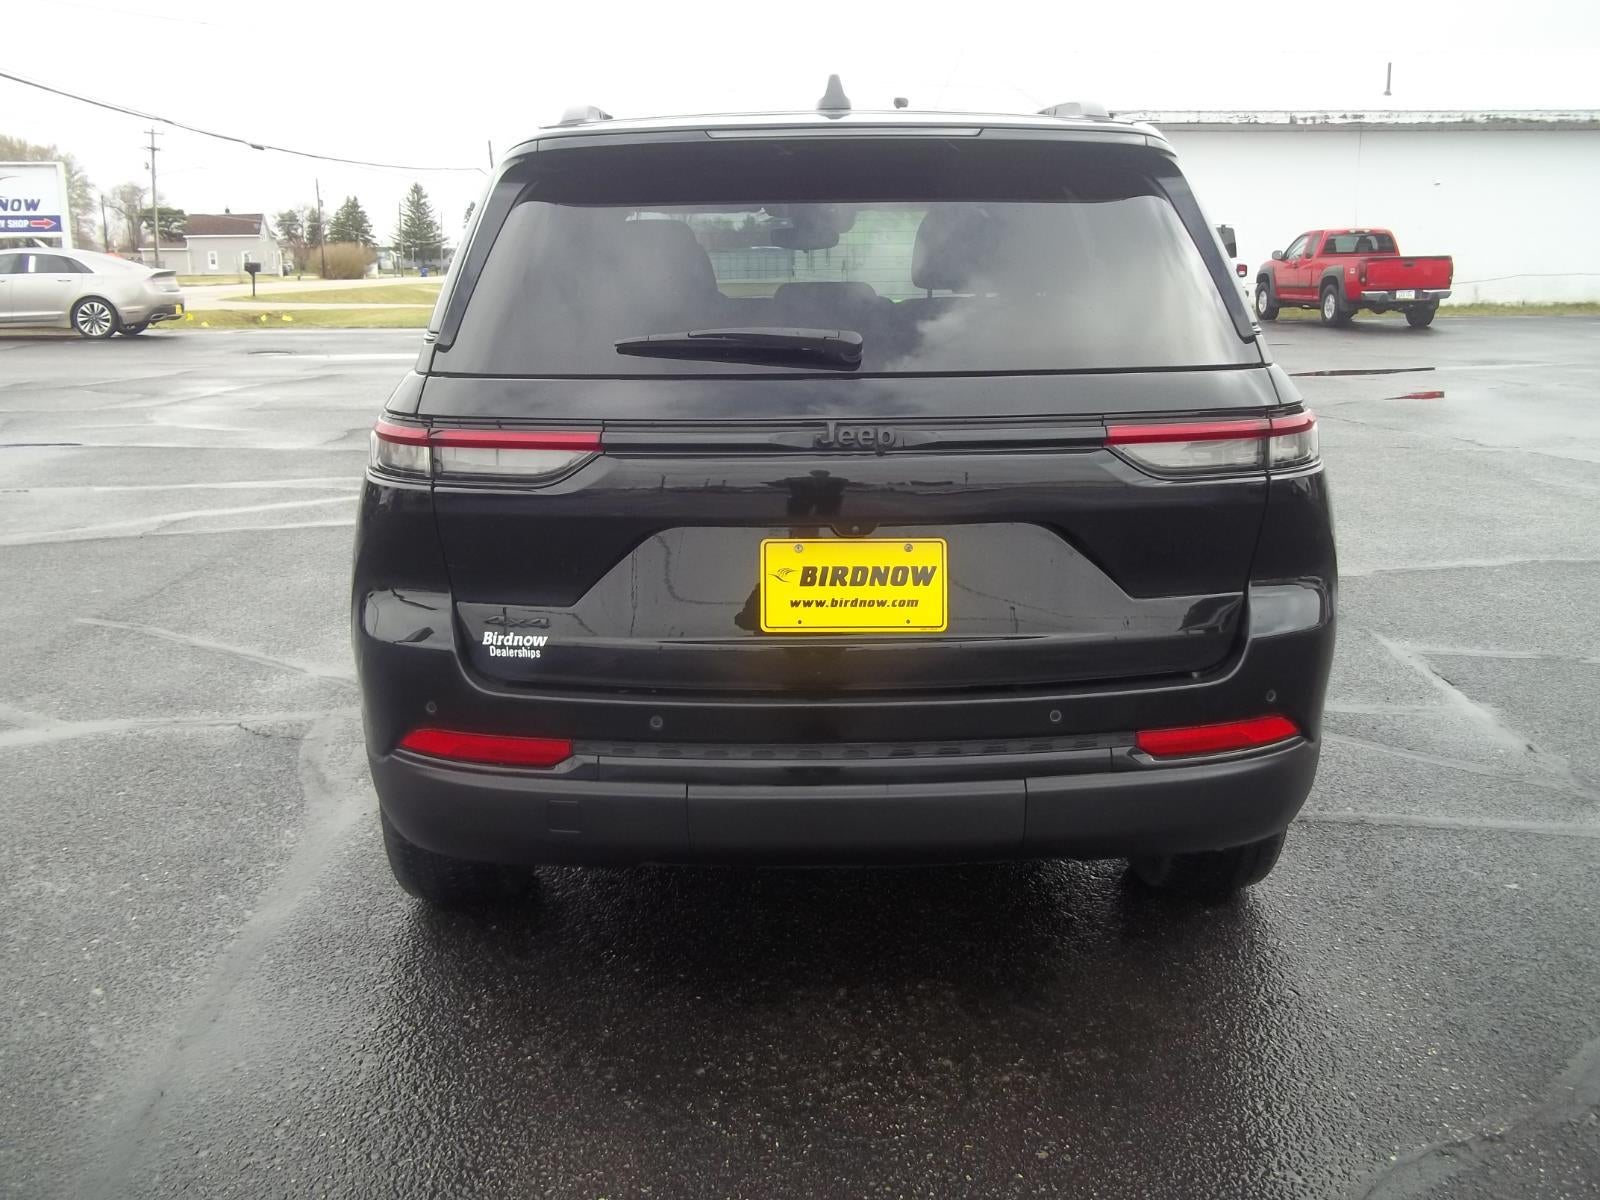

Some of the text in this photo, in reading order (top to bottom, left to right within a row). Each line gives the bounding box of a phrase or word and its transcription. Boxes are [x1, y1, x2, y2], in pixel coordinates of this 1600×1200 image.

[815, 420, 896, 456] Jeep
[799, 565, 937, 587] BIRDNOW
[790, 597, 919, 608] www.birdnow.com
[482, 631, 548, 647] Birdnow
[489, 646, 541, 659] Dealerships
